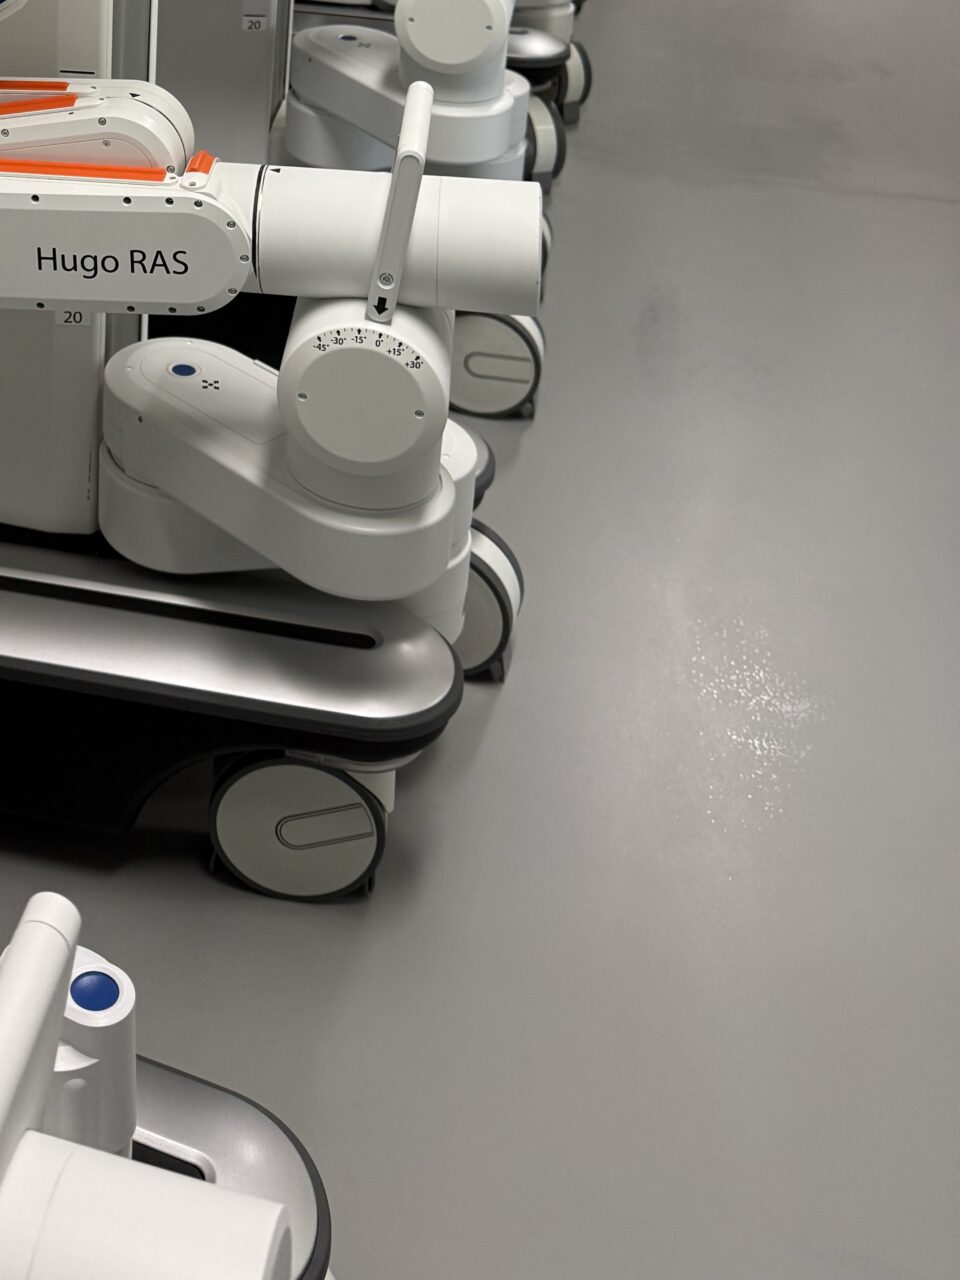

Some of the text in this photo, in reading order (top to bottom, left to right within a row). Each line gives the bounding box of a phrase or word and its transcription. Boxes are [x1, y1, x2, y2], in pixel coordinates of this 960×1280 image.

[247, 20, 261, 30] 20
[36, 246, 189, 279] Hugo RAS
[63, 311, 83, 324] 20
